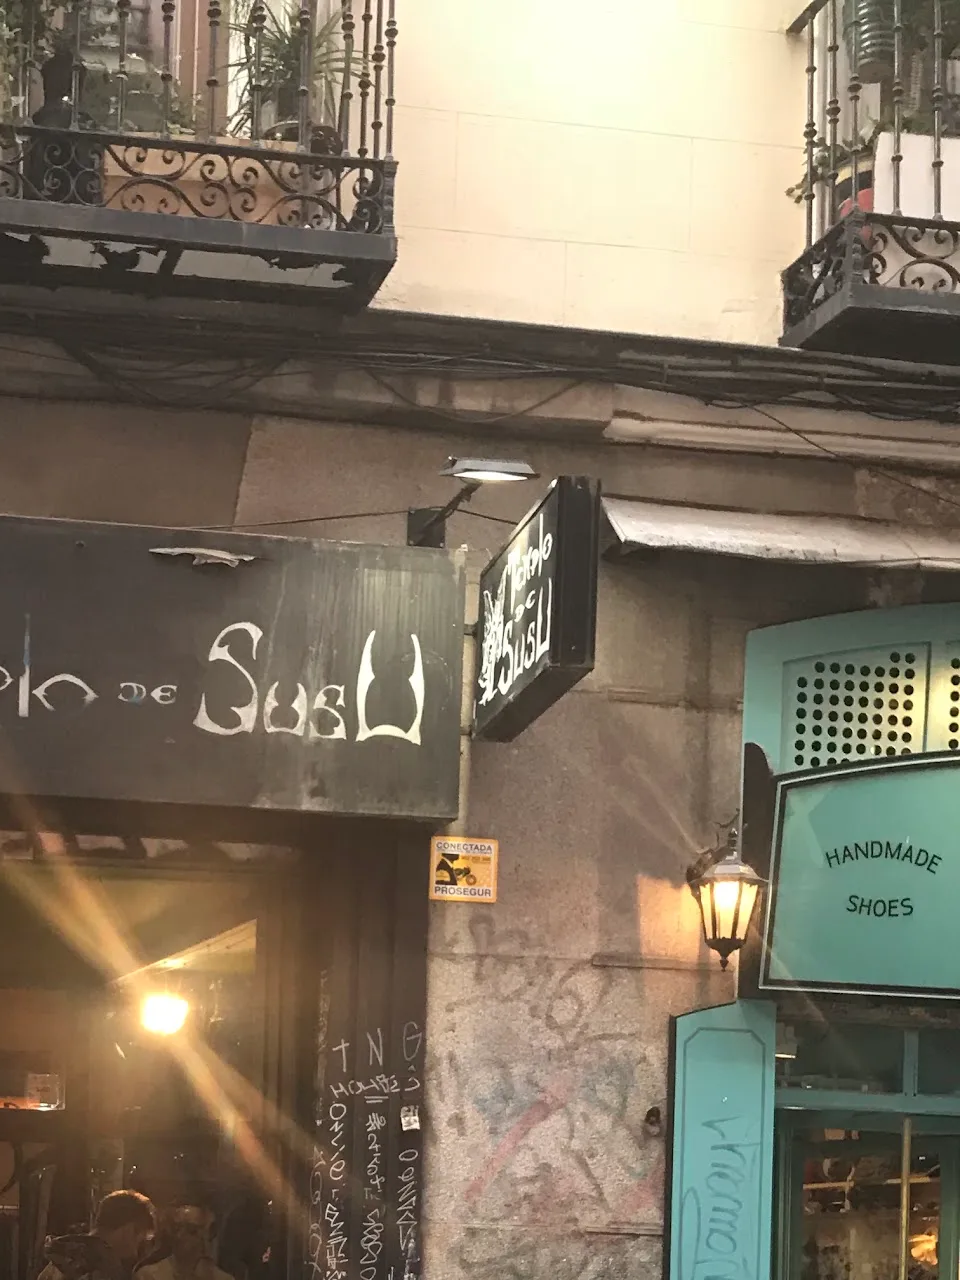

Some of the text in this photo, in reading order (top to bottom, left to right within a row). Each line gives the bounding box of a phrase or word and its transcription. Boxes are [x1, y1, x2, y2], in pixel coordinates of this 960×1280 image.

[436, 841, 493, 852] CONECTADA
[825, 840, 943, 875] HANDMADE
[434, 886, 492, 897] PROSEGUR
[846, 894, 914, 918] SHOES
